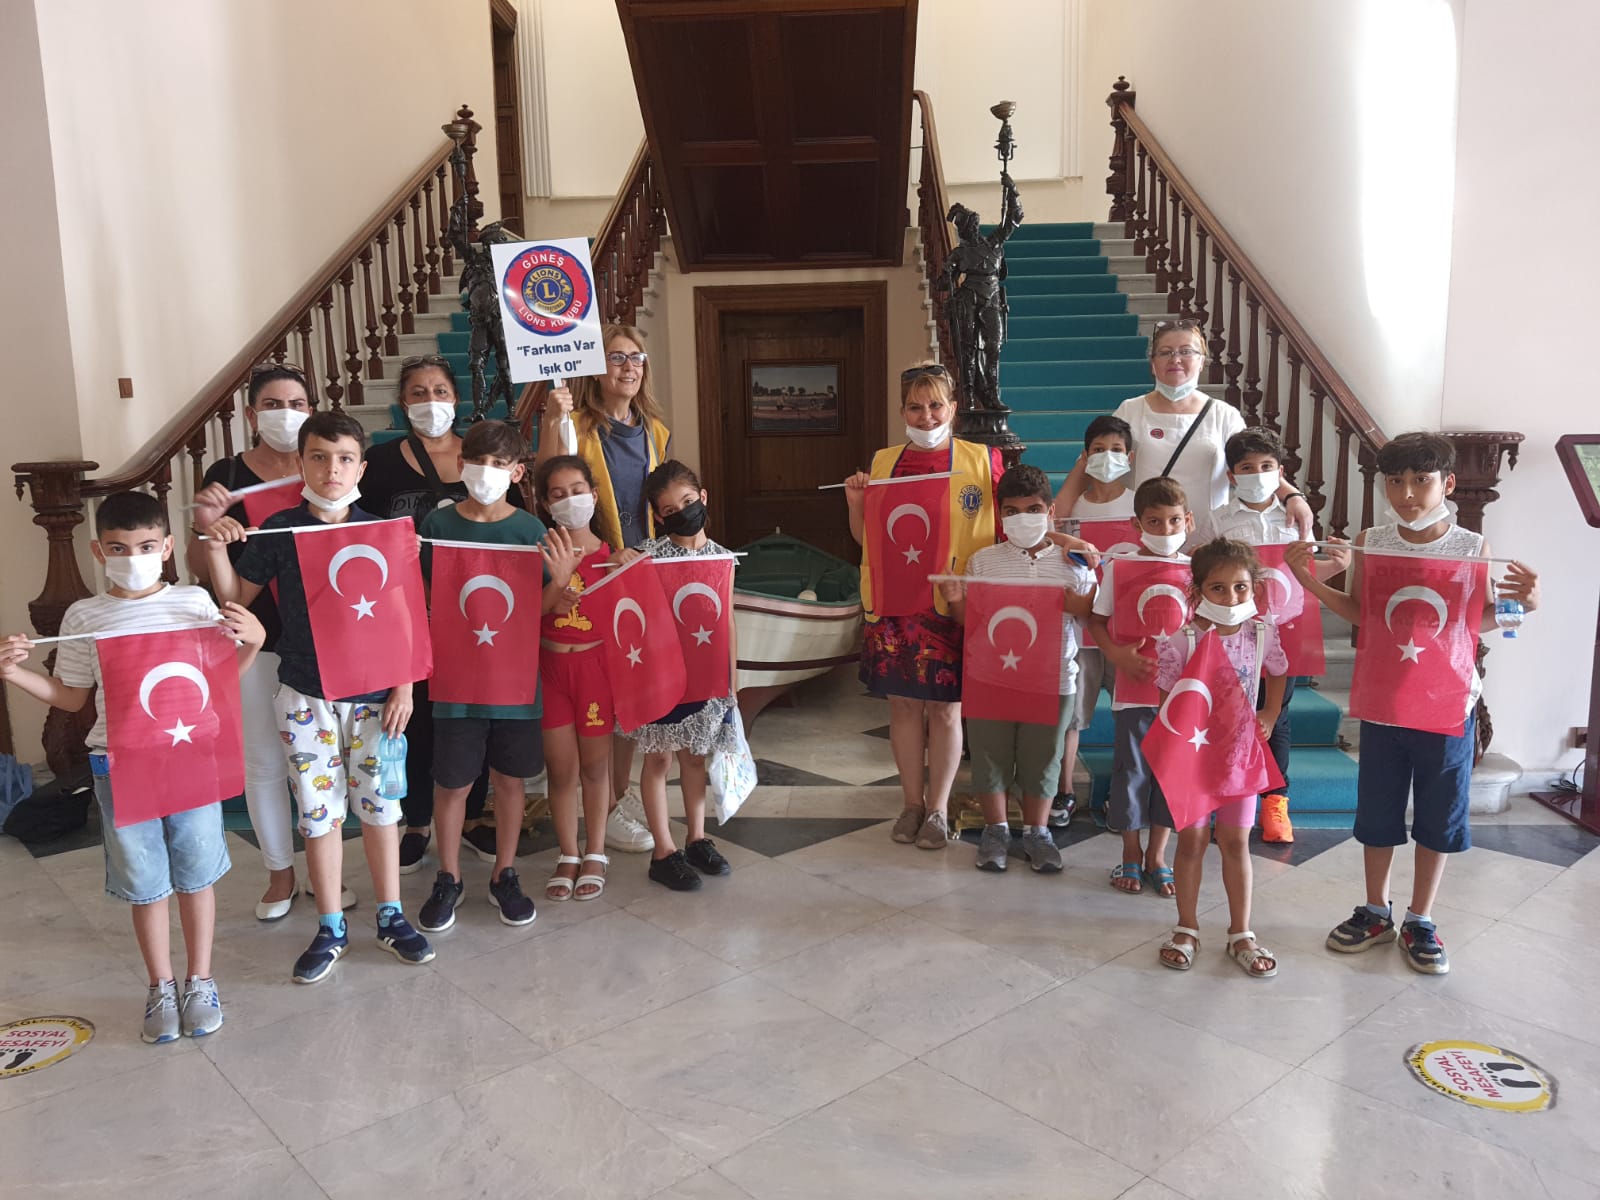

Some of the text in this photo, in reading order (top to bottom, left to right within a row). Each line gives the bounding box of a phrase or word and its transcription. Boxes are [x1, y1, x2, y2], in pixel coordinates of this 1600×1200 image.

[532, 269, 560, 281] LIONS
[543, 282, 556, 298] L
[518, 306, 546, 327] LIONS
[573, 340, 596, 352] Var
[539, 361, 562, 376] Işık
[1434, 1055, 1475, 1091] SOSYAL
